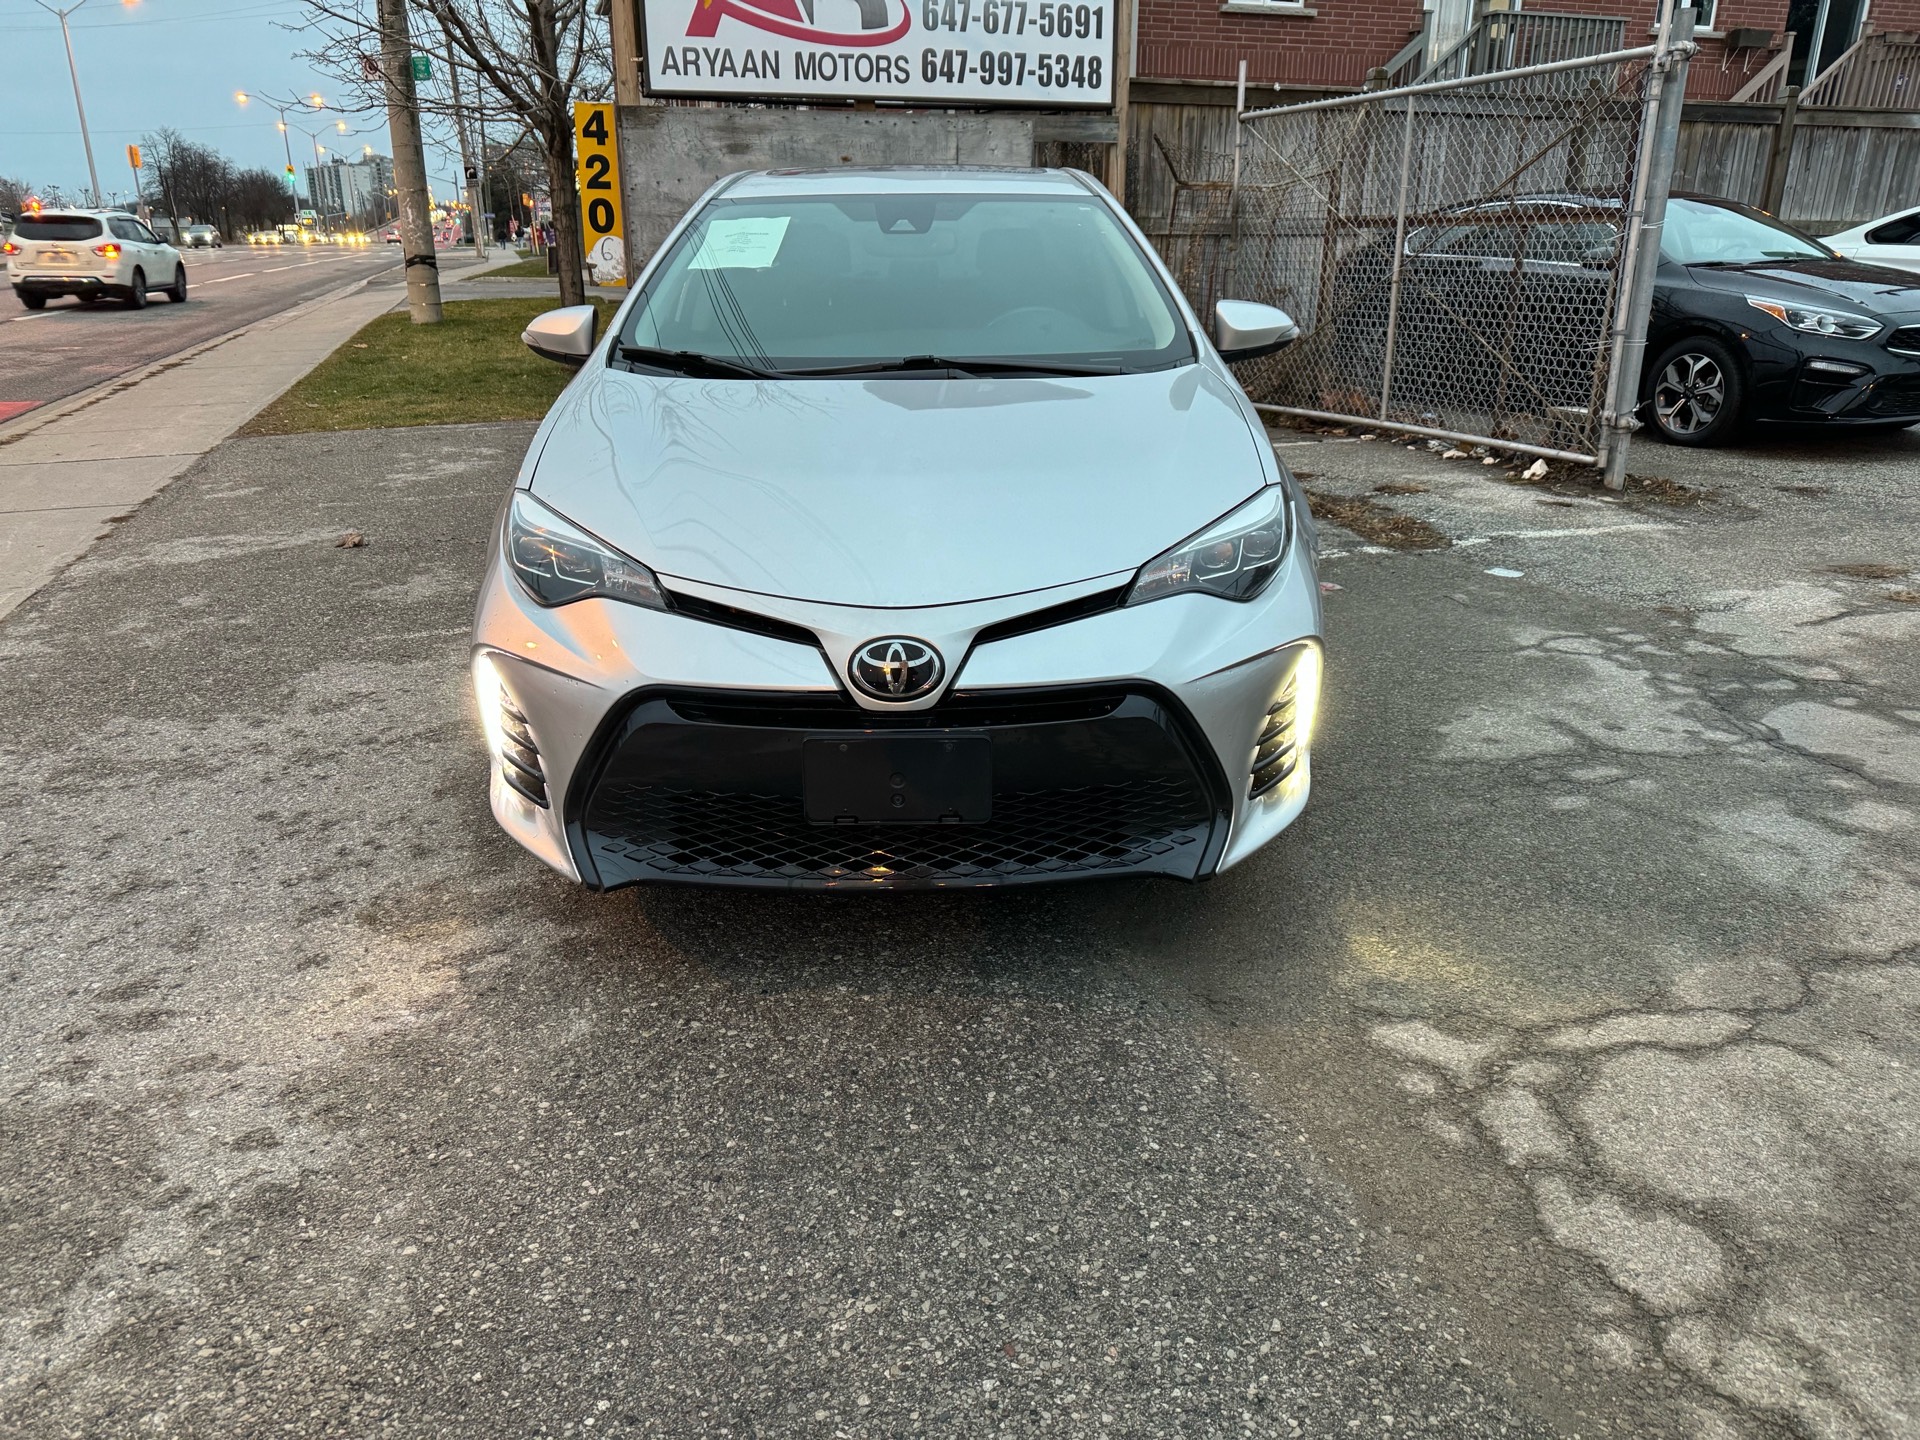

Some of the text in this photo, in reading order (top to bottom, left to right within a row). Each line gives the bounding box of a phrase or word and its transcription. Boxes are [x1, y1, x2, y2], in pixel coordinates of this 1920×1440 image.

[922, 0, 1103, 39] 647-677-5691
[661, 46, 910, 83] ARYAAN MOTORS
[921, 48, 1102, 89] 647-997-5348
[582, 110, 615, 233] 420
